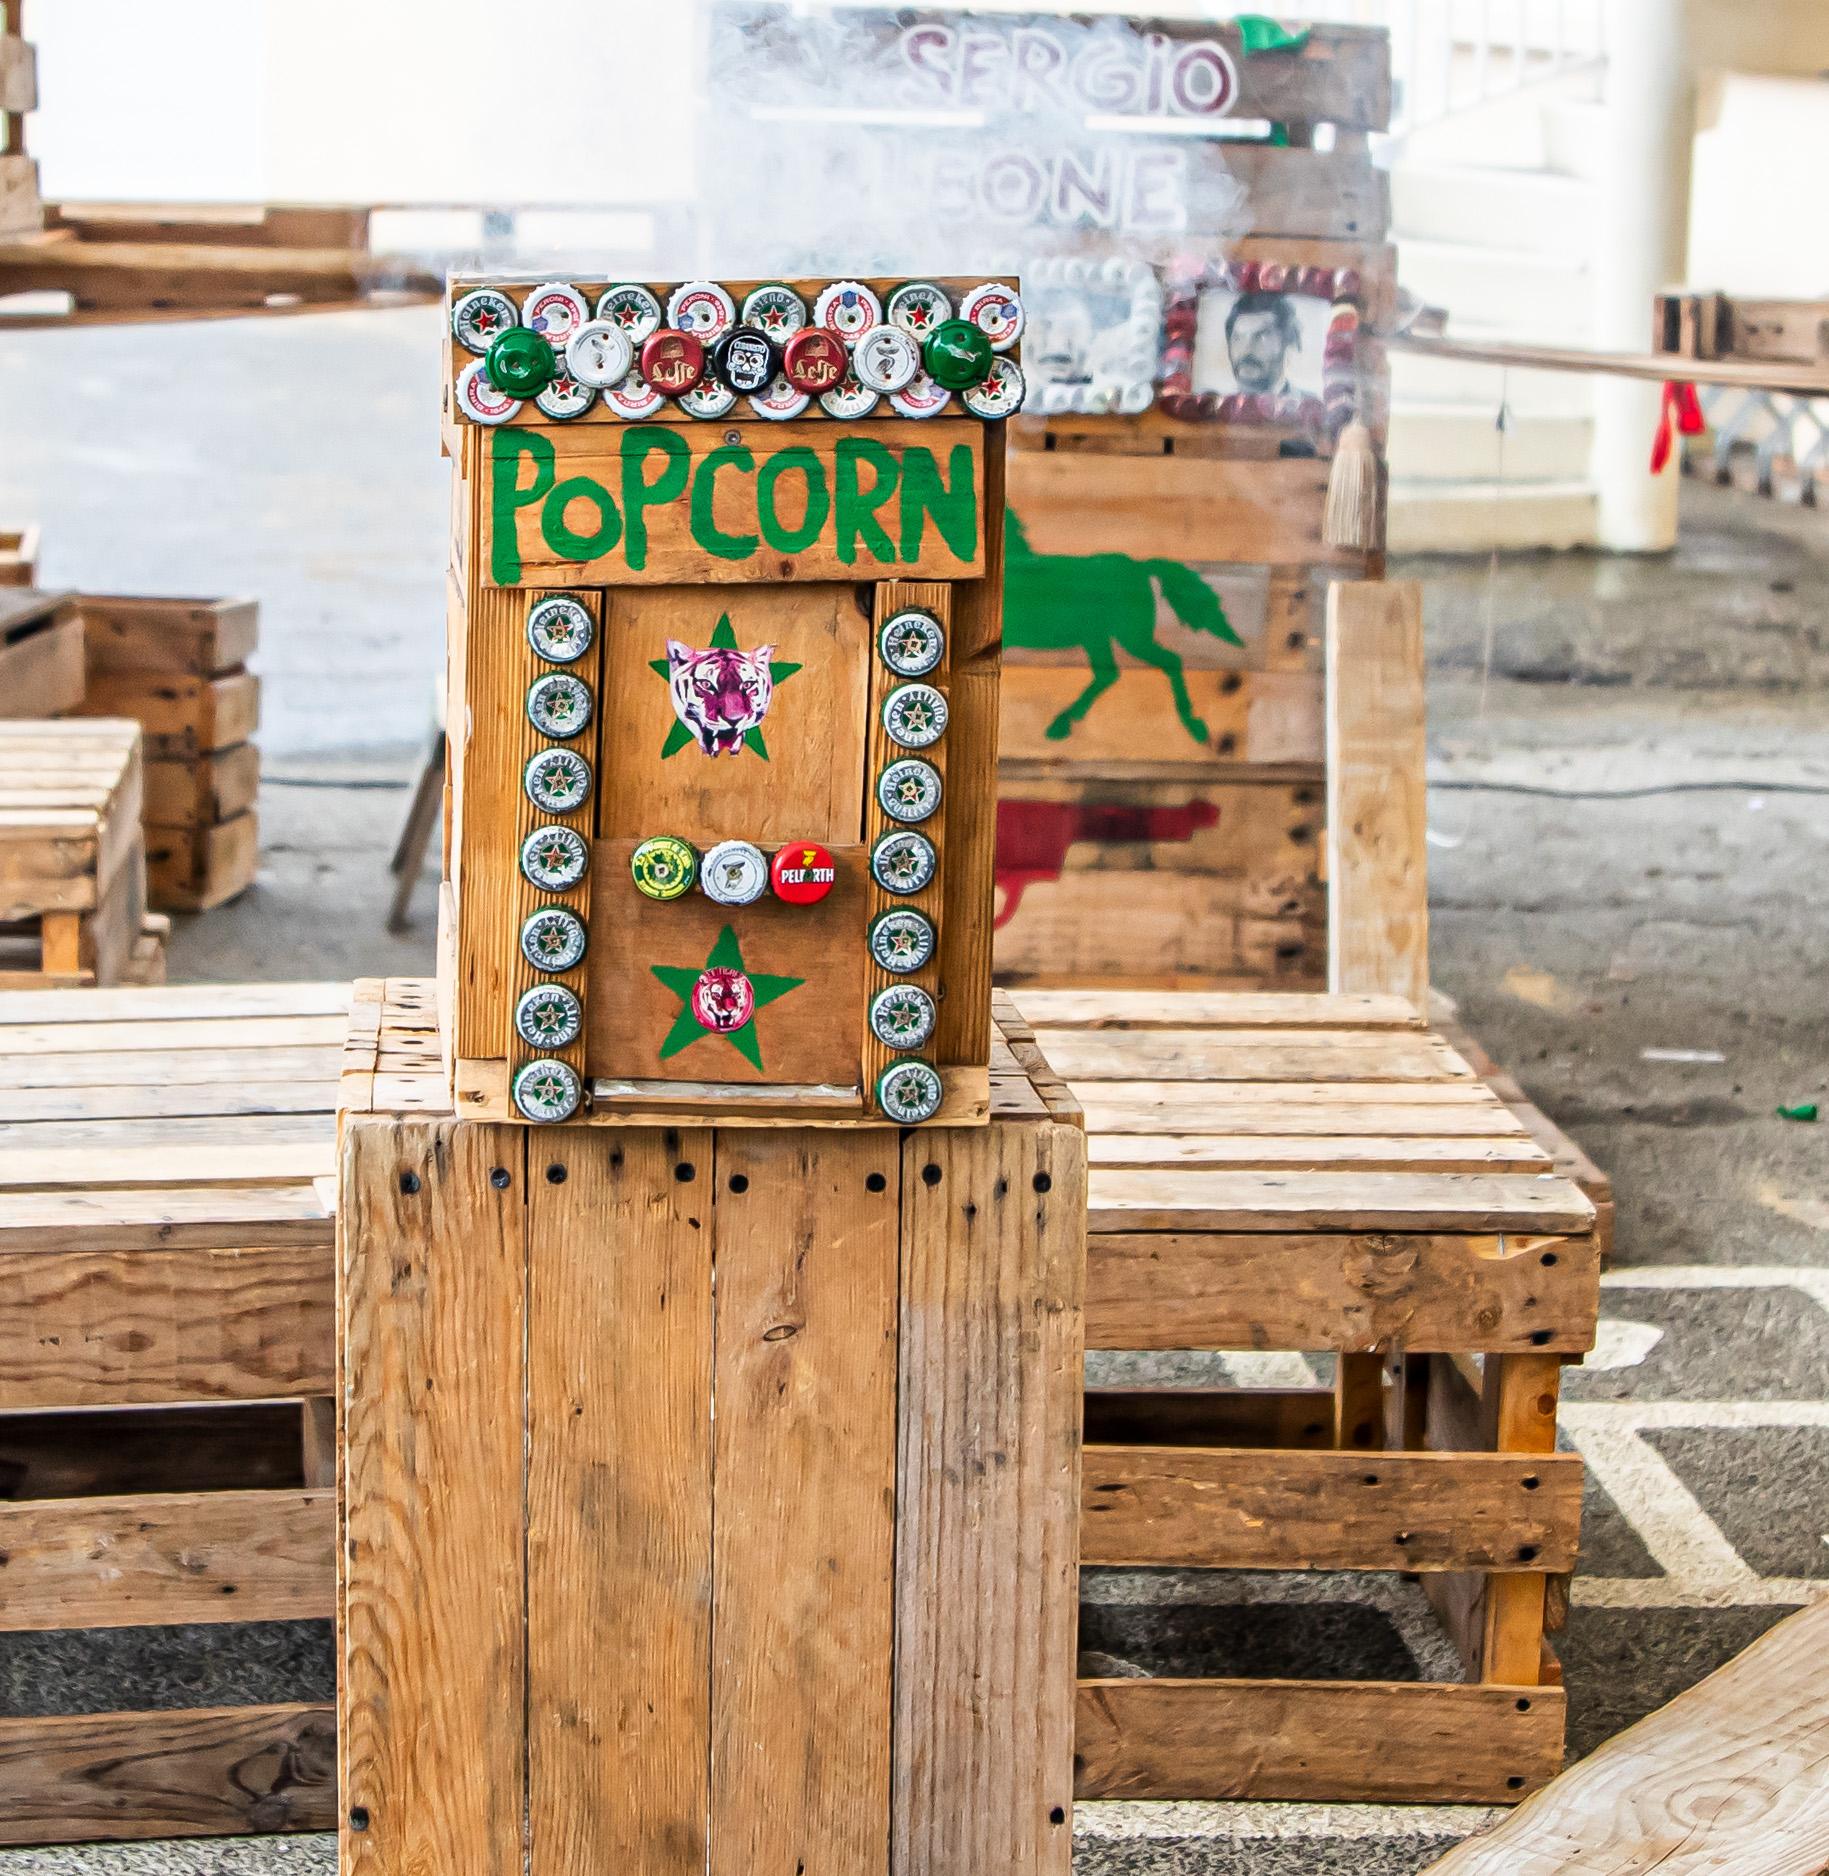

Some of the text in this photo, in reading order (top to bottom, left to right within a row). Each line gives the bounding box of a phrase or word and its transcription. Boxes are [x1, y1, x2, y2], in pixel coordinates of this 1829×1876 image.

[926, 147, 1188, 232] EONE
[460, 295, 512, 331] Heineken
[603, 290, 655, 320] Heineken
[651, 359, 696, 388] Leffe
[892, 700, 939, 744] Heineken
[781, 868, 834, 884] PELFRTH
[525, 992, 561, 1042] Heineken
